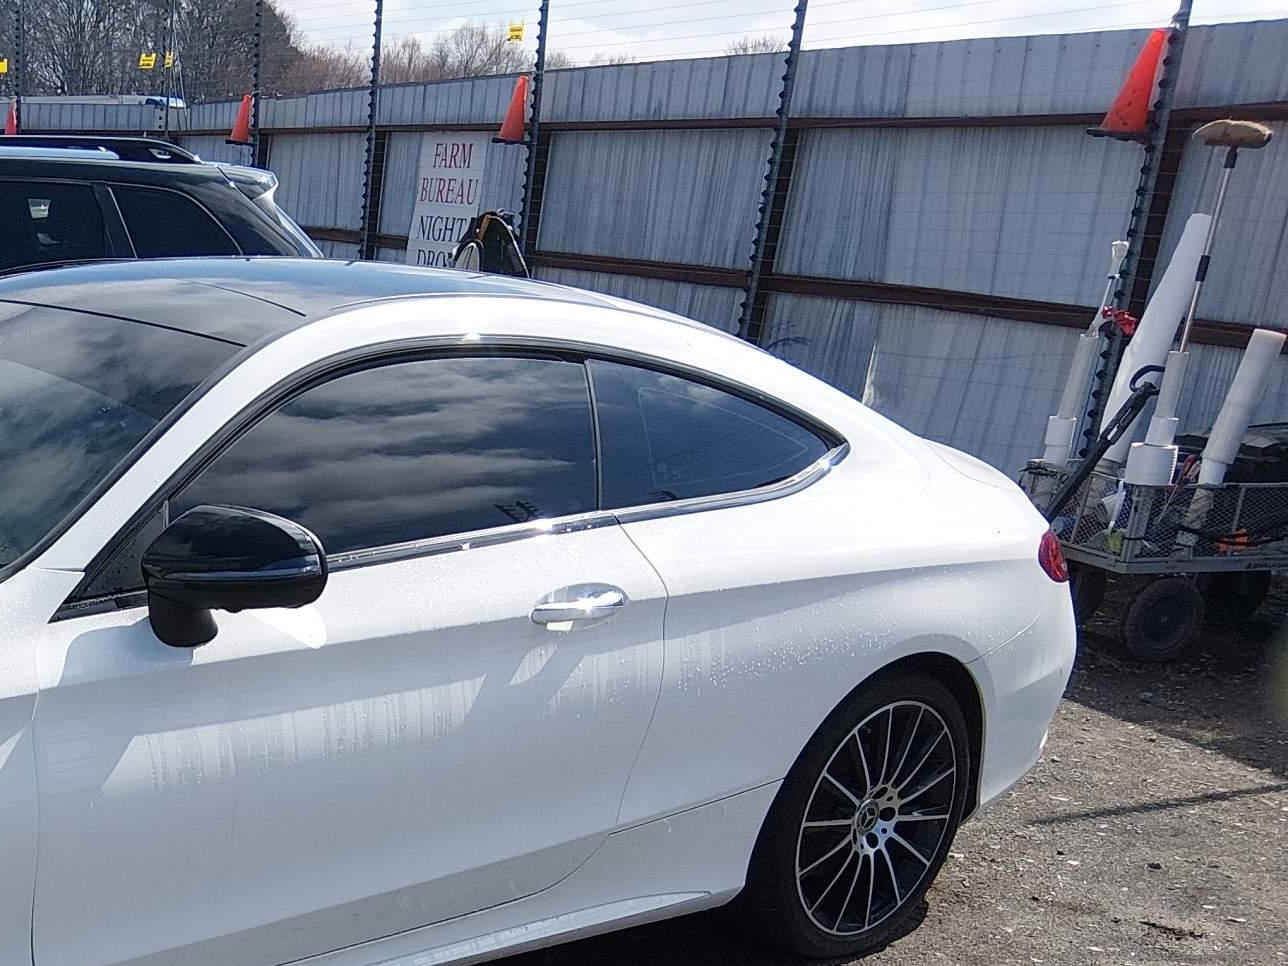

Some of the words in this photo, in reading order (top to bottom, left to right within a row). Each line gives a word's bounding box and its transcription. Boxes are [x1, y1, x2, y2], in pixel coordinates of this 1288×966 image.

[432, 142, 475, 169] FARM
[419, 177, 479, 205] BUREAU
[416, 215, 468, 242] NIGHT
